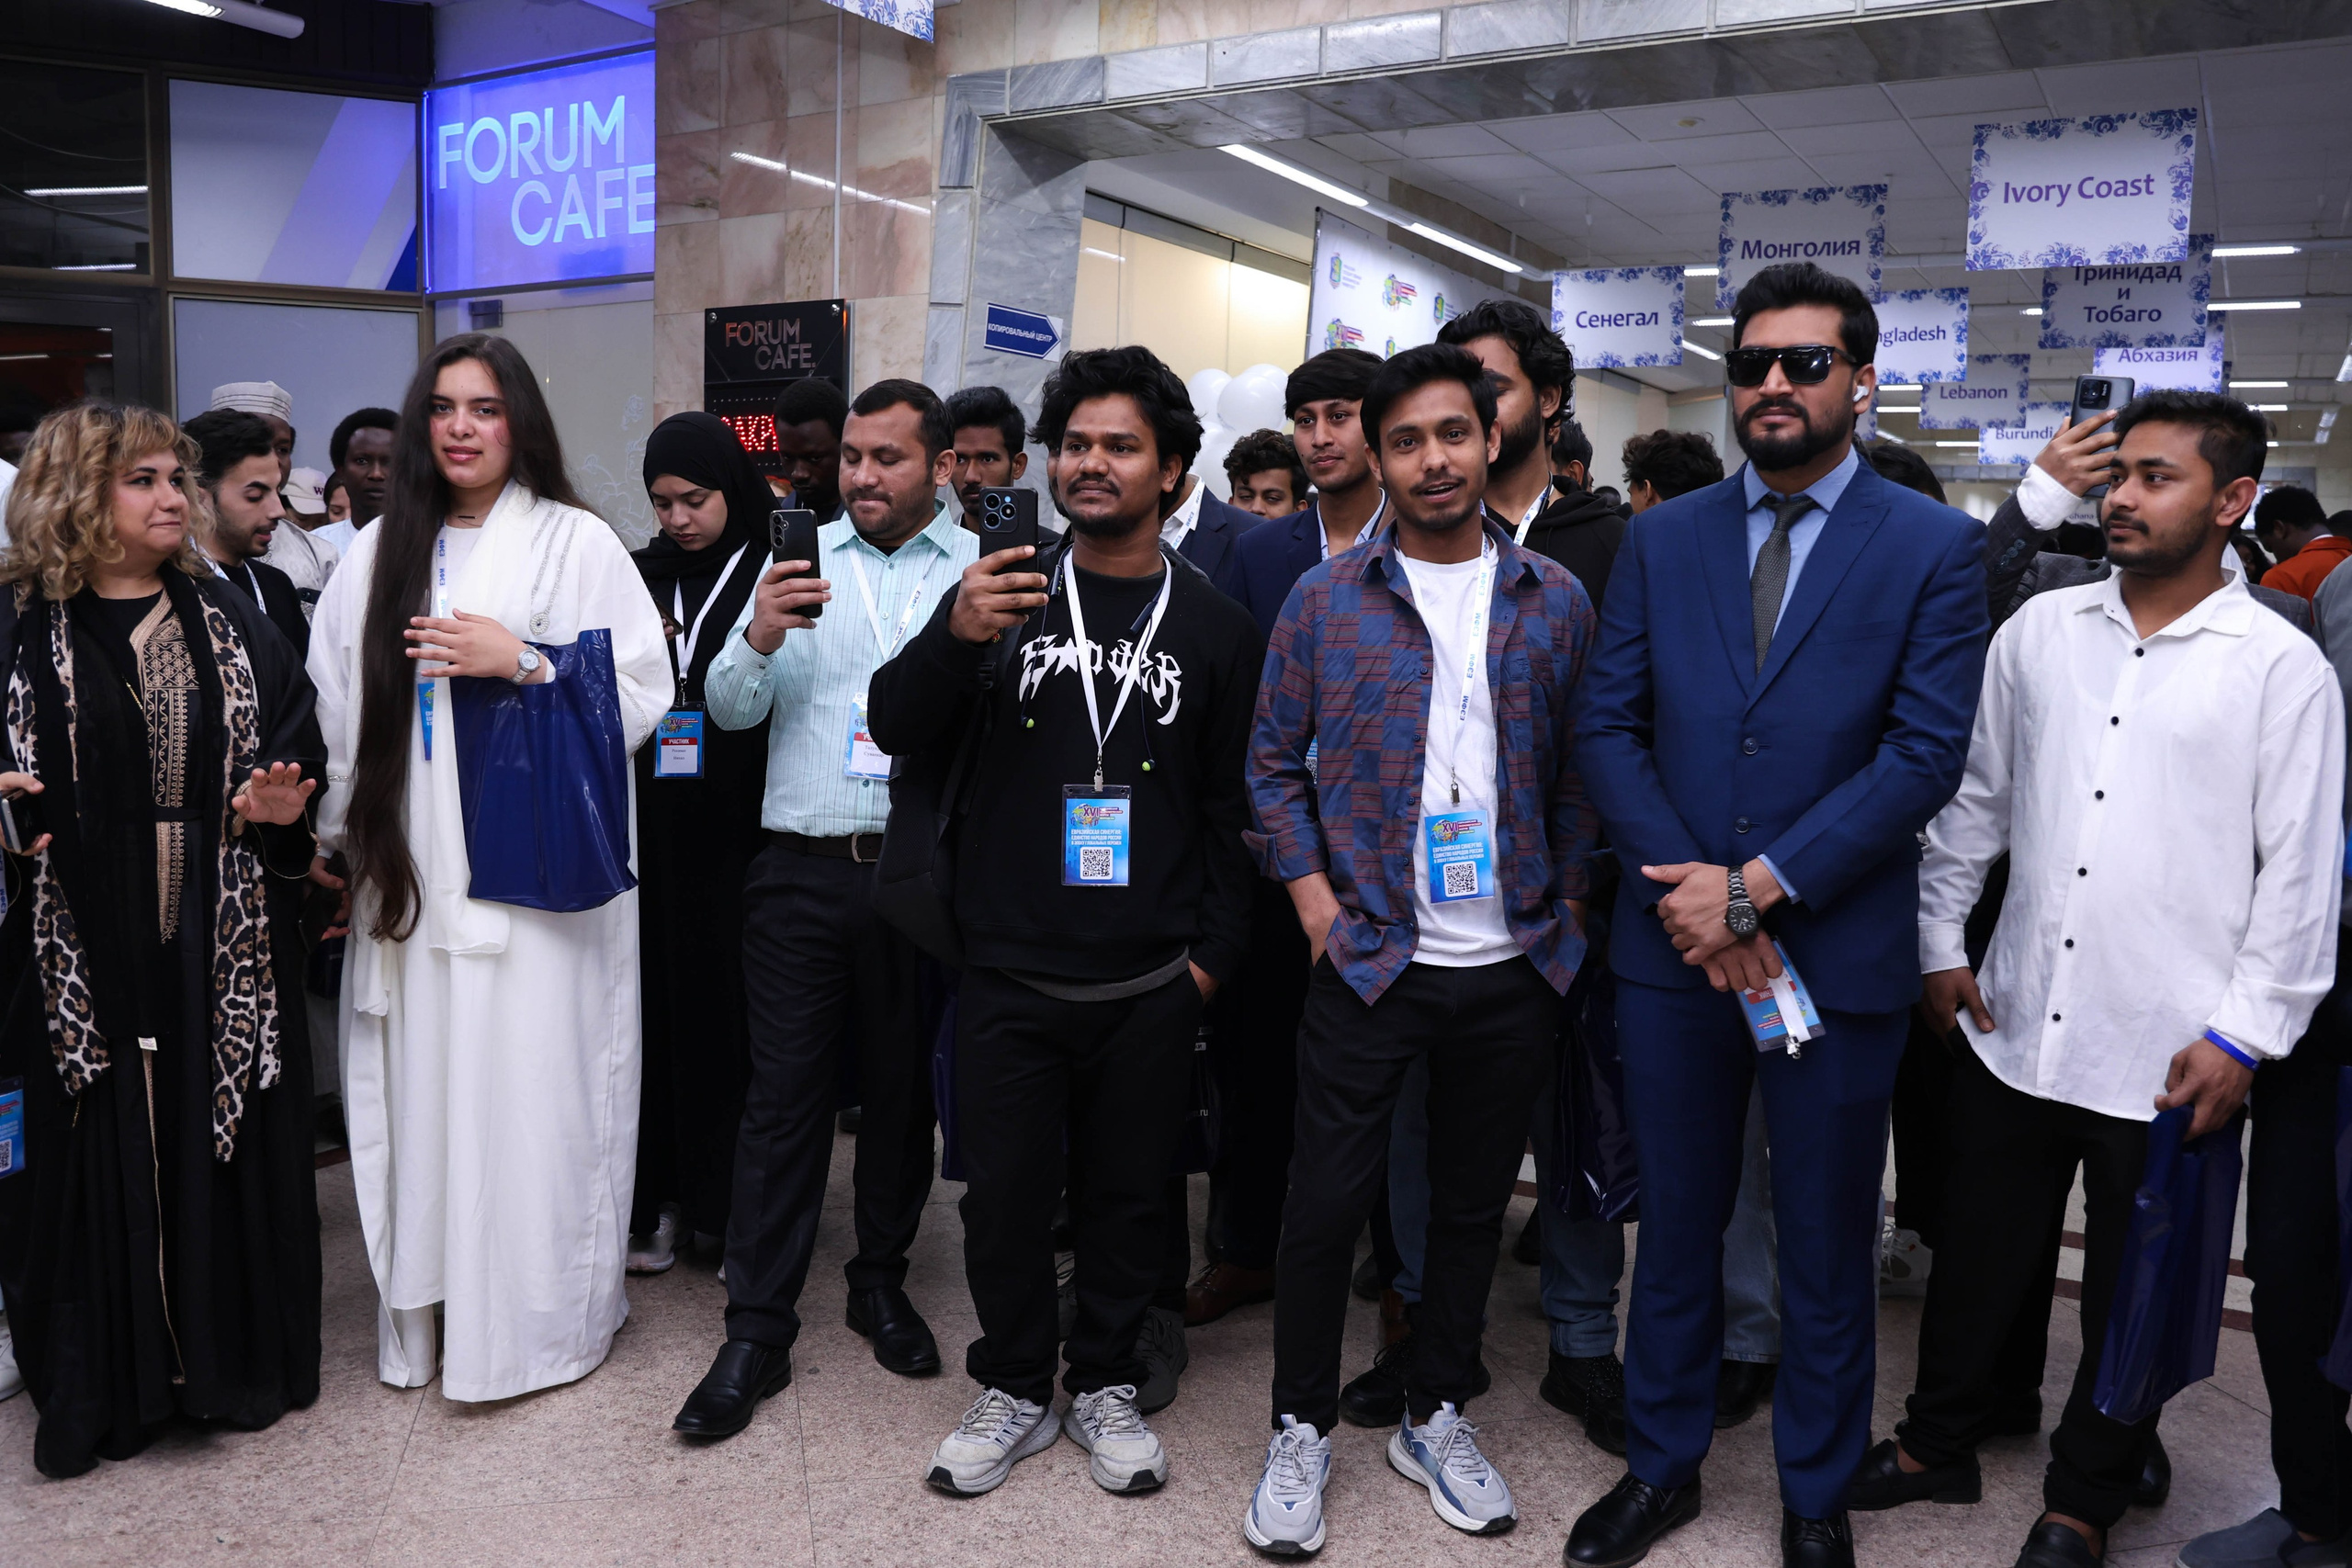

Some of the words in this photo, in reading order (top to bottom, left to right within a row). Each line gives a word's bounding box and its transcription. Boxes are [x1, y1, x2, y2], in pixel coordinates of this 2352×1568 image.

[438, 95, 626, 189] FORUM
[2003, 182, 2072, 208] Ivory
[2077, 174, 2155, 199] Coast
[511, 164, 656, 246] CAFE
[1740, 239, 1860, 260] Монголия
[2074, 265, 2182, 286] Тринидад
[2117, 288, 2131, 300] и
[1576, 310, 1659, 329] Сенегал
[2083, 304, 2162, 323] Тобаго
[725, 318, 801, 347] FORUM
[988, 323, 1035, 340] КОПИРОВАЛЬНЫЙ
[1035, 332, 1053, 343] ЦЕНТР
[1878, 325, 1947, 348] ngladesh
[754, 343, 817, 370] CAFE.
[2118, 347, 2199, 363] Абхазия
[1939, 385, 2008, 400] Lebanon
[1996, 426, 2053, 440] Burundi
[1466, 653, 1476, 679] ЕЭФМ
[1459, 694, 1469, 721] ЕЭФМ
[1084, 807, 1099, 816] XVI
[1443, 822, 1458, 832] XVI
